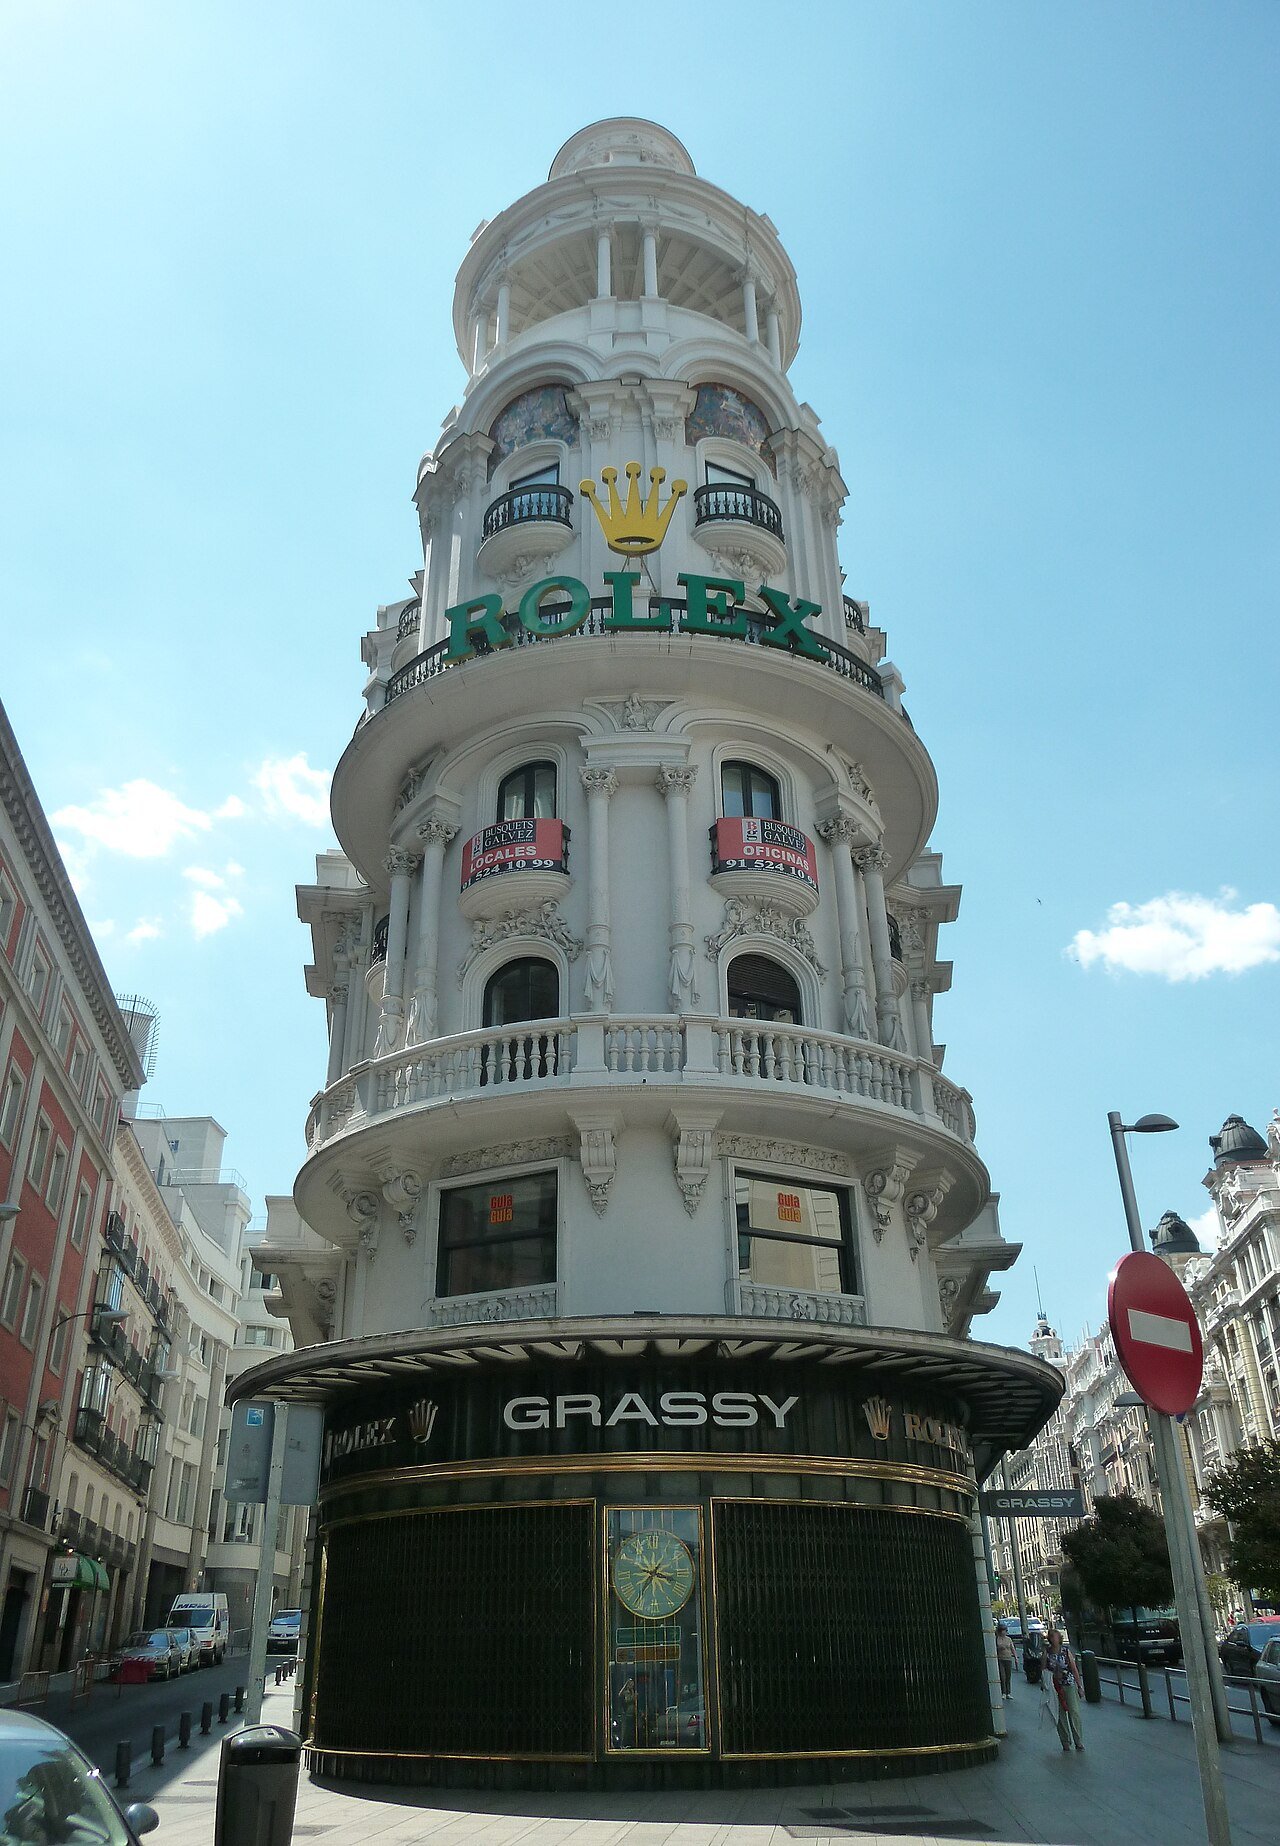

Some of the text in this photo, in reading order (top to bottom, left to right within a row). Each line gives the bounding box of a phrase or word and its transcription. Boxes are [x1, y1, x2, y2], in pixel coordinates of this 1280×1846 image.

[442, 571, 832, 666] ROLEX
[484, 829, 534, 847] GALVEZ
[485, 820, 534, 838] BUSQUETS
[764, 821, 805, 842] BUSQUETS
[764, 831, 806, 852] GALVEZ
[470, 845, 537, 873] LOCALES
[743, 845, 809, 871] OFICINAS
[476, 864, 500, 881] 524
[507, 860, 526, 870] 10
[532, 859, 554, 868] 99
[726, 859, 747, 868] 91
[754, 860, 785, 872] 524
[790, 866, 805, 879] 10
[503, 1391, 800, 1430] GRASSY
[996, 1497, 1076, 1508] GRASSY
